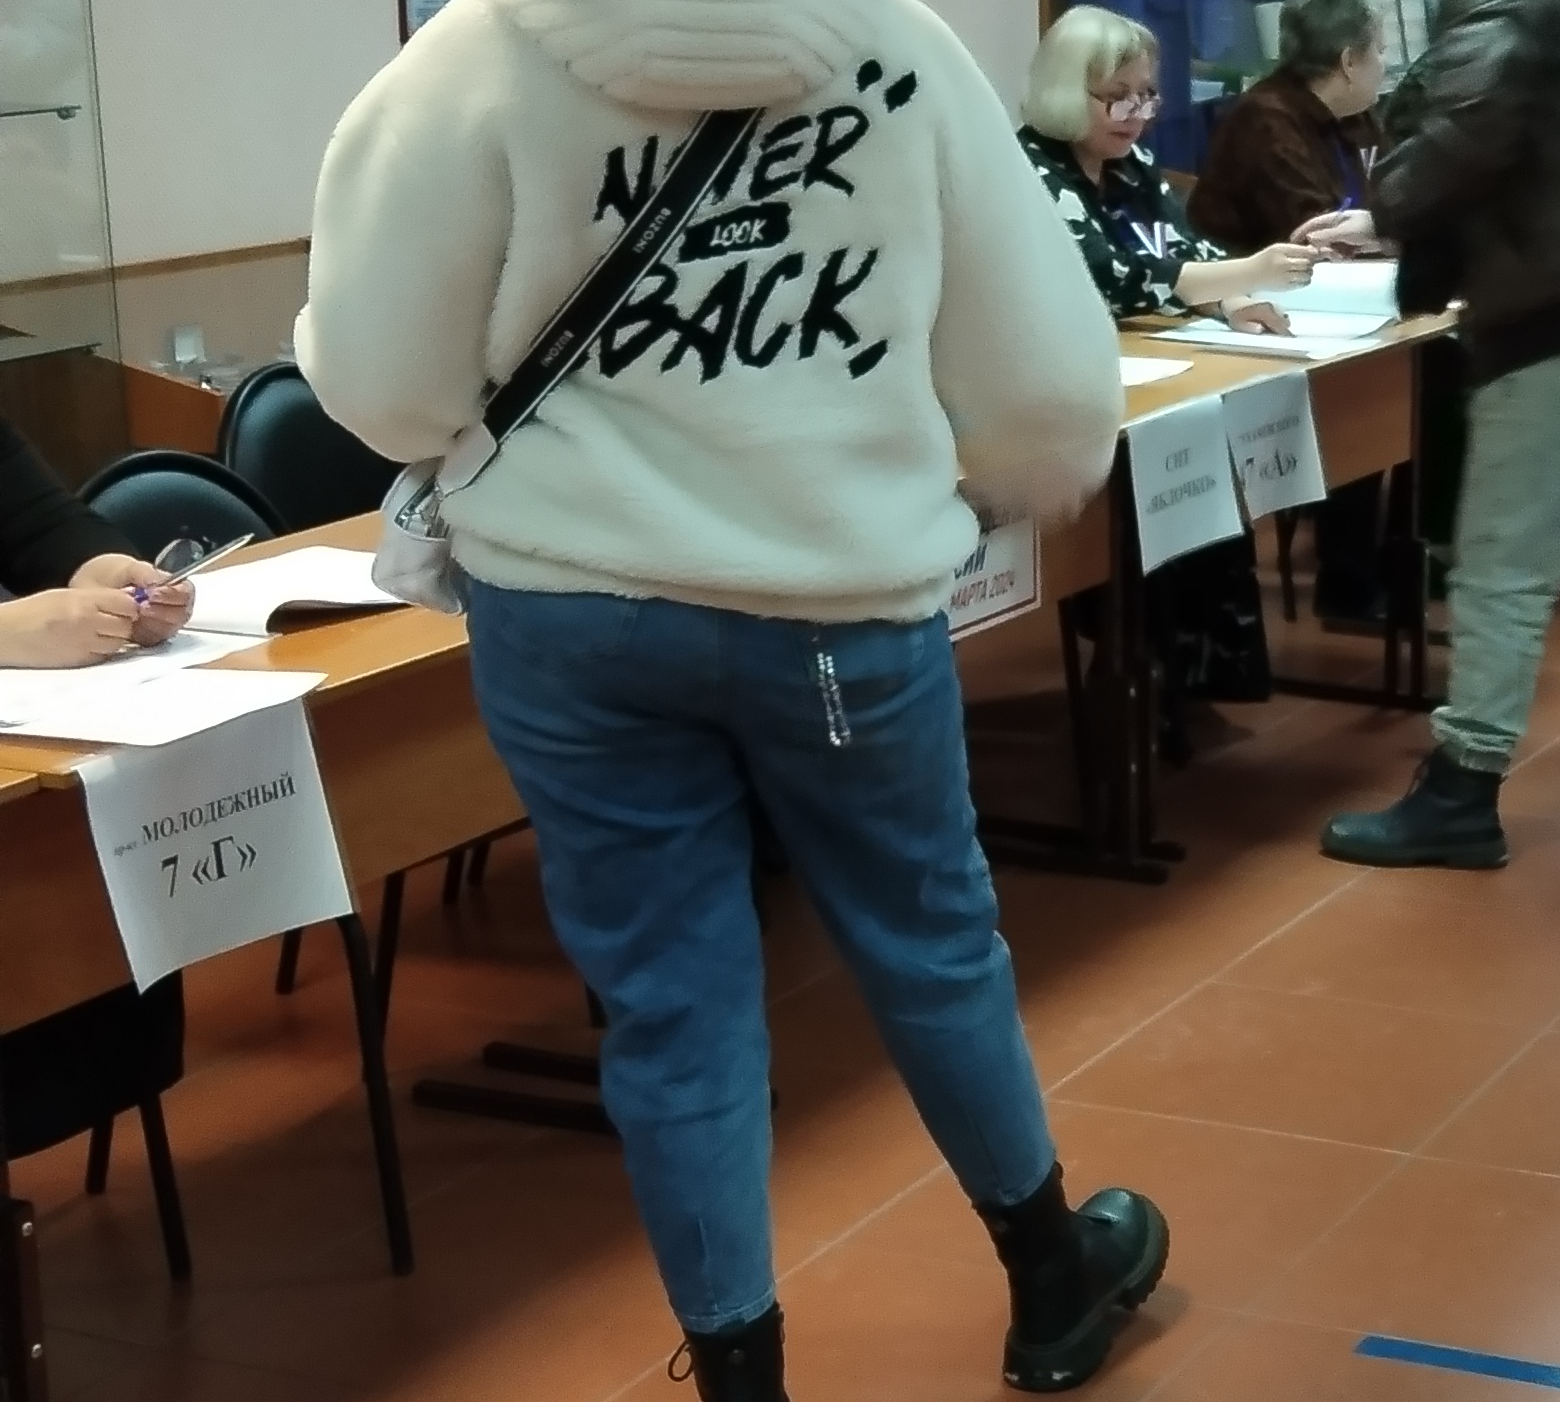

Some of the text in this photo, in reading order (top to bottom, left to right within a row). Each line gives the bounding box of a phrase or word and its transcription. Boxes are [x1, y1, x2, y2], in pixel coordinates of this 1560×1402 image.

[710, 218, 767, 247] LOOK
[142, 770, 297, 846] МОЛОДЕЖНЫЙ
[160, 834, 258, 898] 7 «Г»
